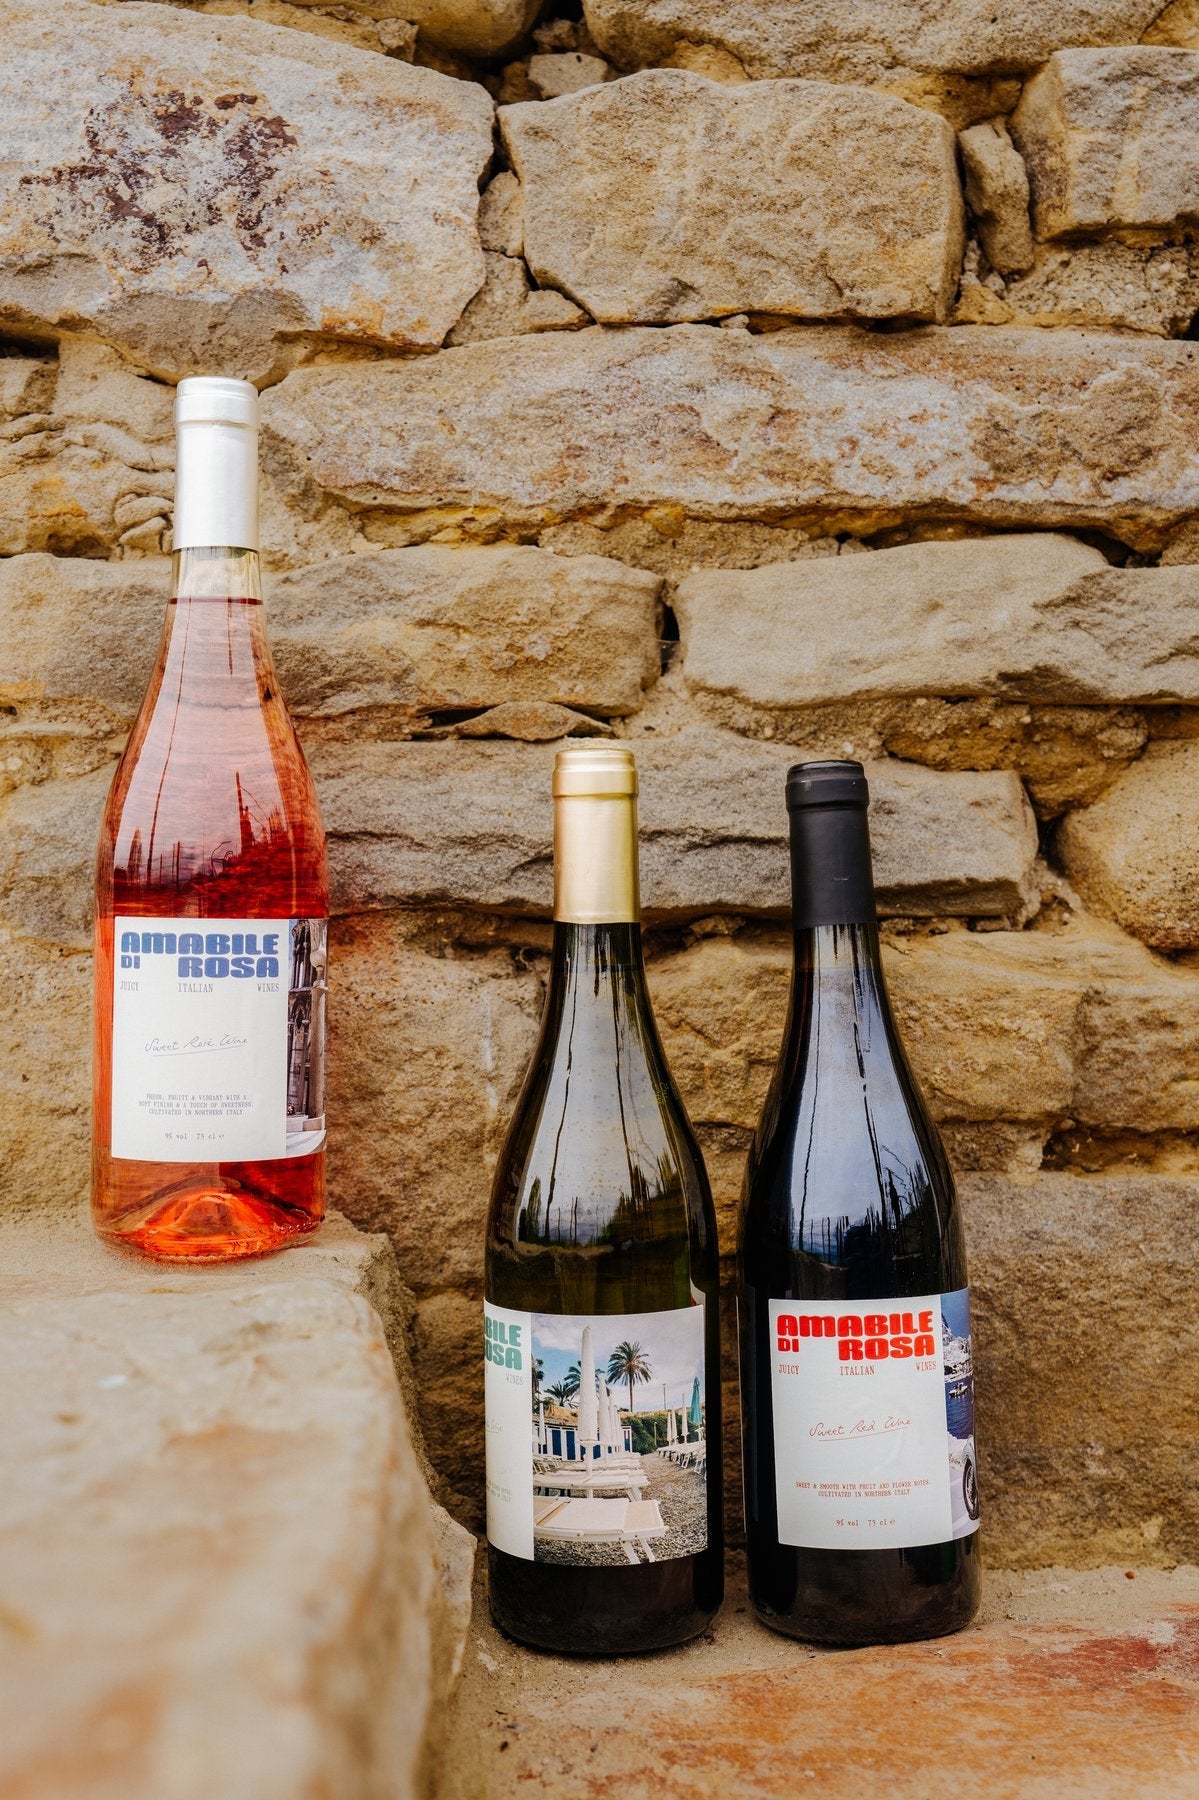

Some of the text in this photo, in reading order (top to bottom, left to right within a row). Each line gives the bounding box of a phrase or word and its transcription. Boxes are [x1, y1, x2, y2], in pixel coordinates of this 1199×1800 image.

[121, 932, 279, 955] AMABILE
[121, 955, 279, 978] DI ROSA
[120, 981, 279, 993] JUICY ITALIAN WINES
[144, 1037, 180, 1052] Sweet
[219, 1033, 248, 1046] Wine
[196, 1132, 205, 1140] 75
[777, 1310, 934, 1338] AMABILE
[777, 1334, 935, 1361] DI ROSA
[778, 1360, 937, 1376] JUICY ITALIAN WINES
[809, 1416, 912, 1437] Sweet Red Wine
[818, 1490, 851, 1498] CULTIVATED
[848, 1519, 859, 1527] vol
